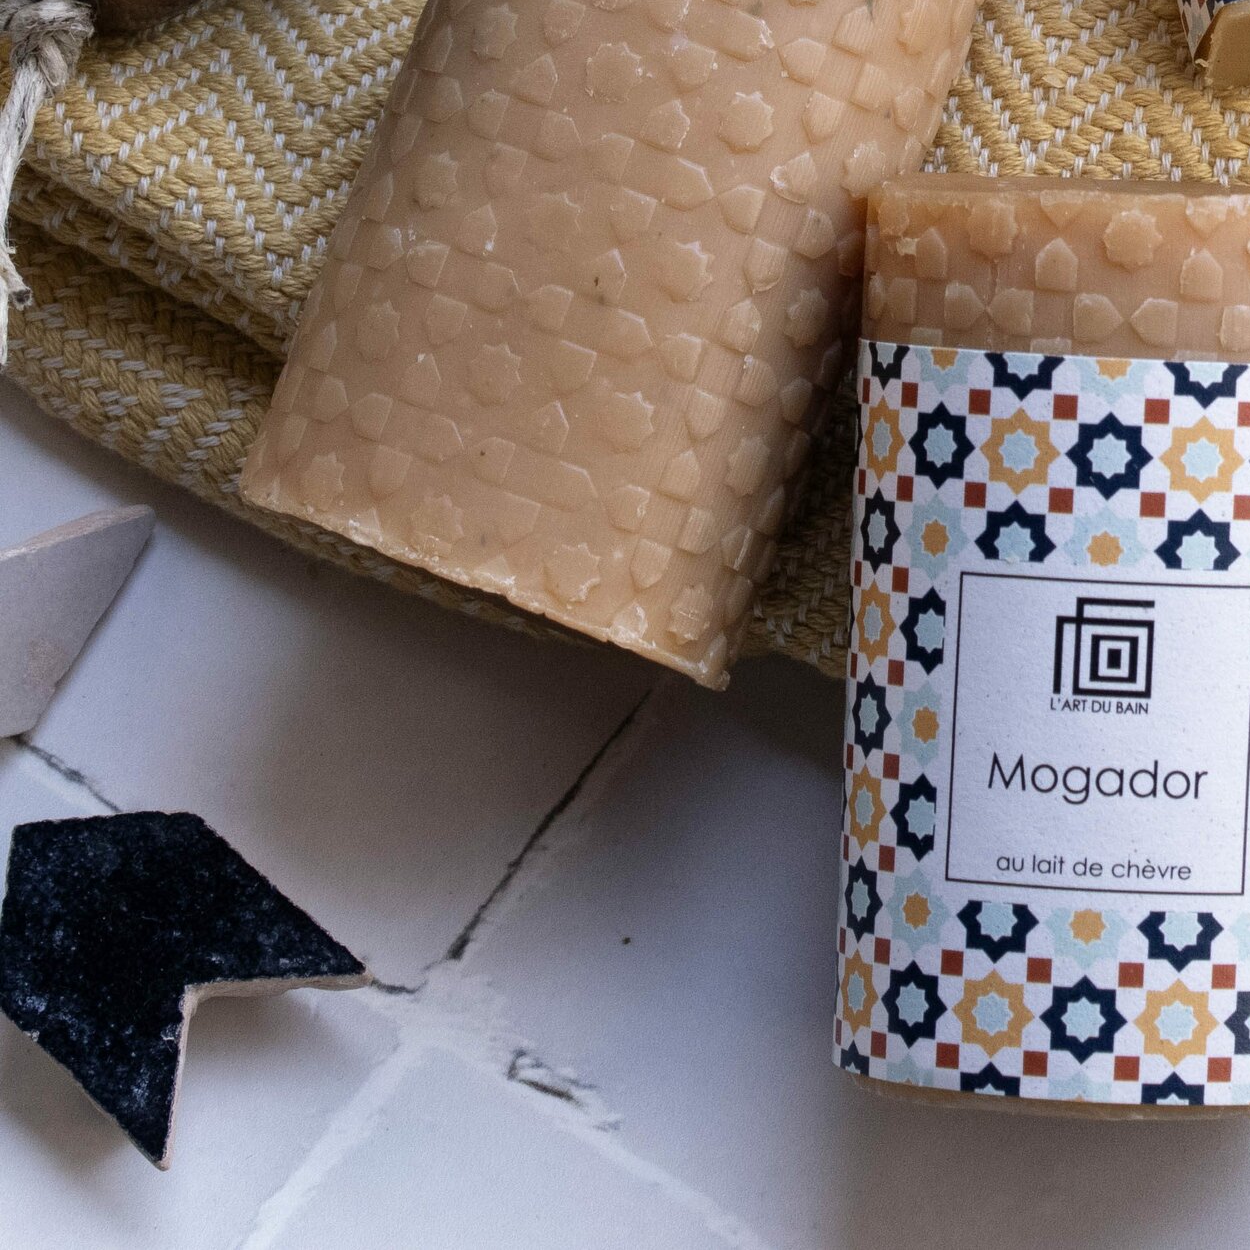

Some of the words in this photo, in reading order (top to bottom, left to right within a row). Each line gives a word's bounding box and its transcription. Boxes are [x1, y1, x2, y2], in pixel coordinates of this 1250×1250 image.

[1050, 697, 1087, 712] L'ART
[1091, 699, 1112, 714] DU
[1115, 701, 1149, 715] BAIN
[987, 751, 1208, 806] Mogador
[996, 856, 1025, 873] au
[1032, 854, 1065, 875] lait
[1072, 857, 1104, 878] de
[1111, 858, 1192, 881] chèvre
